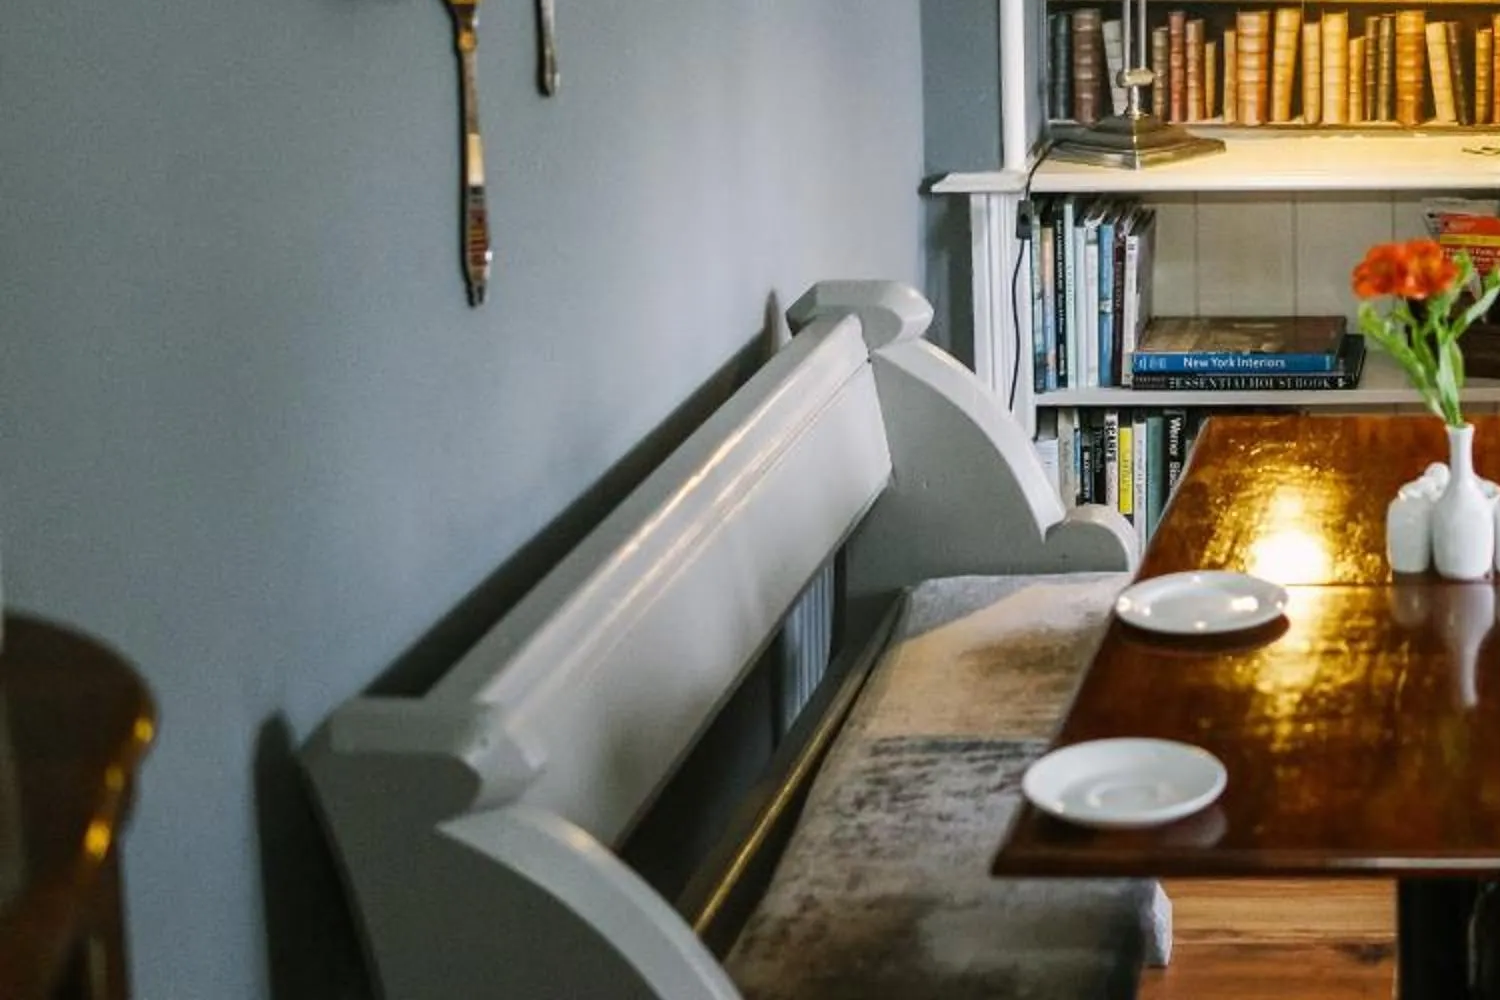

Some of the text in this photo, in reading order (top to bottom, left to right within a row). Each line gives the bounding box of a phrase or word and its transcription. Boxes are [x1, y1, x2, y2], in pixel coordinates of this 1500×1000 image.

[1183, 357, 1286, 369] New York Interiors
[1170, 417, 1182, 456] Werner
